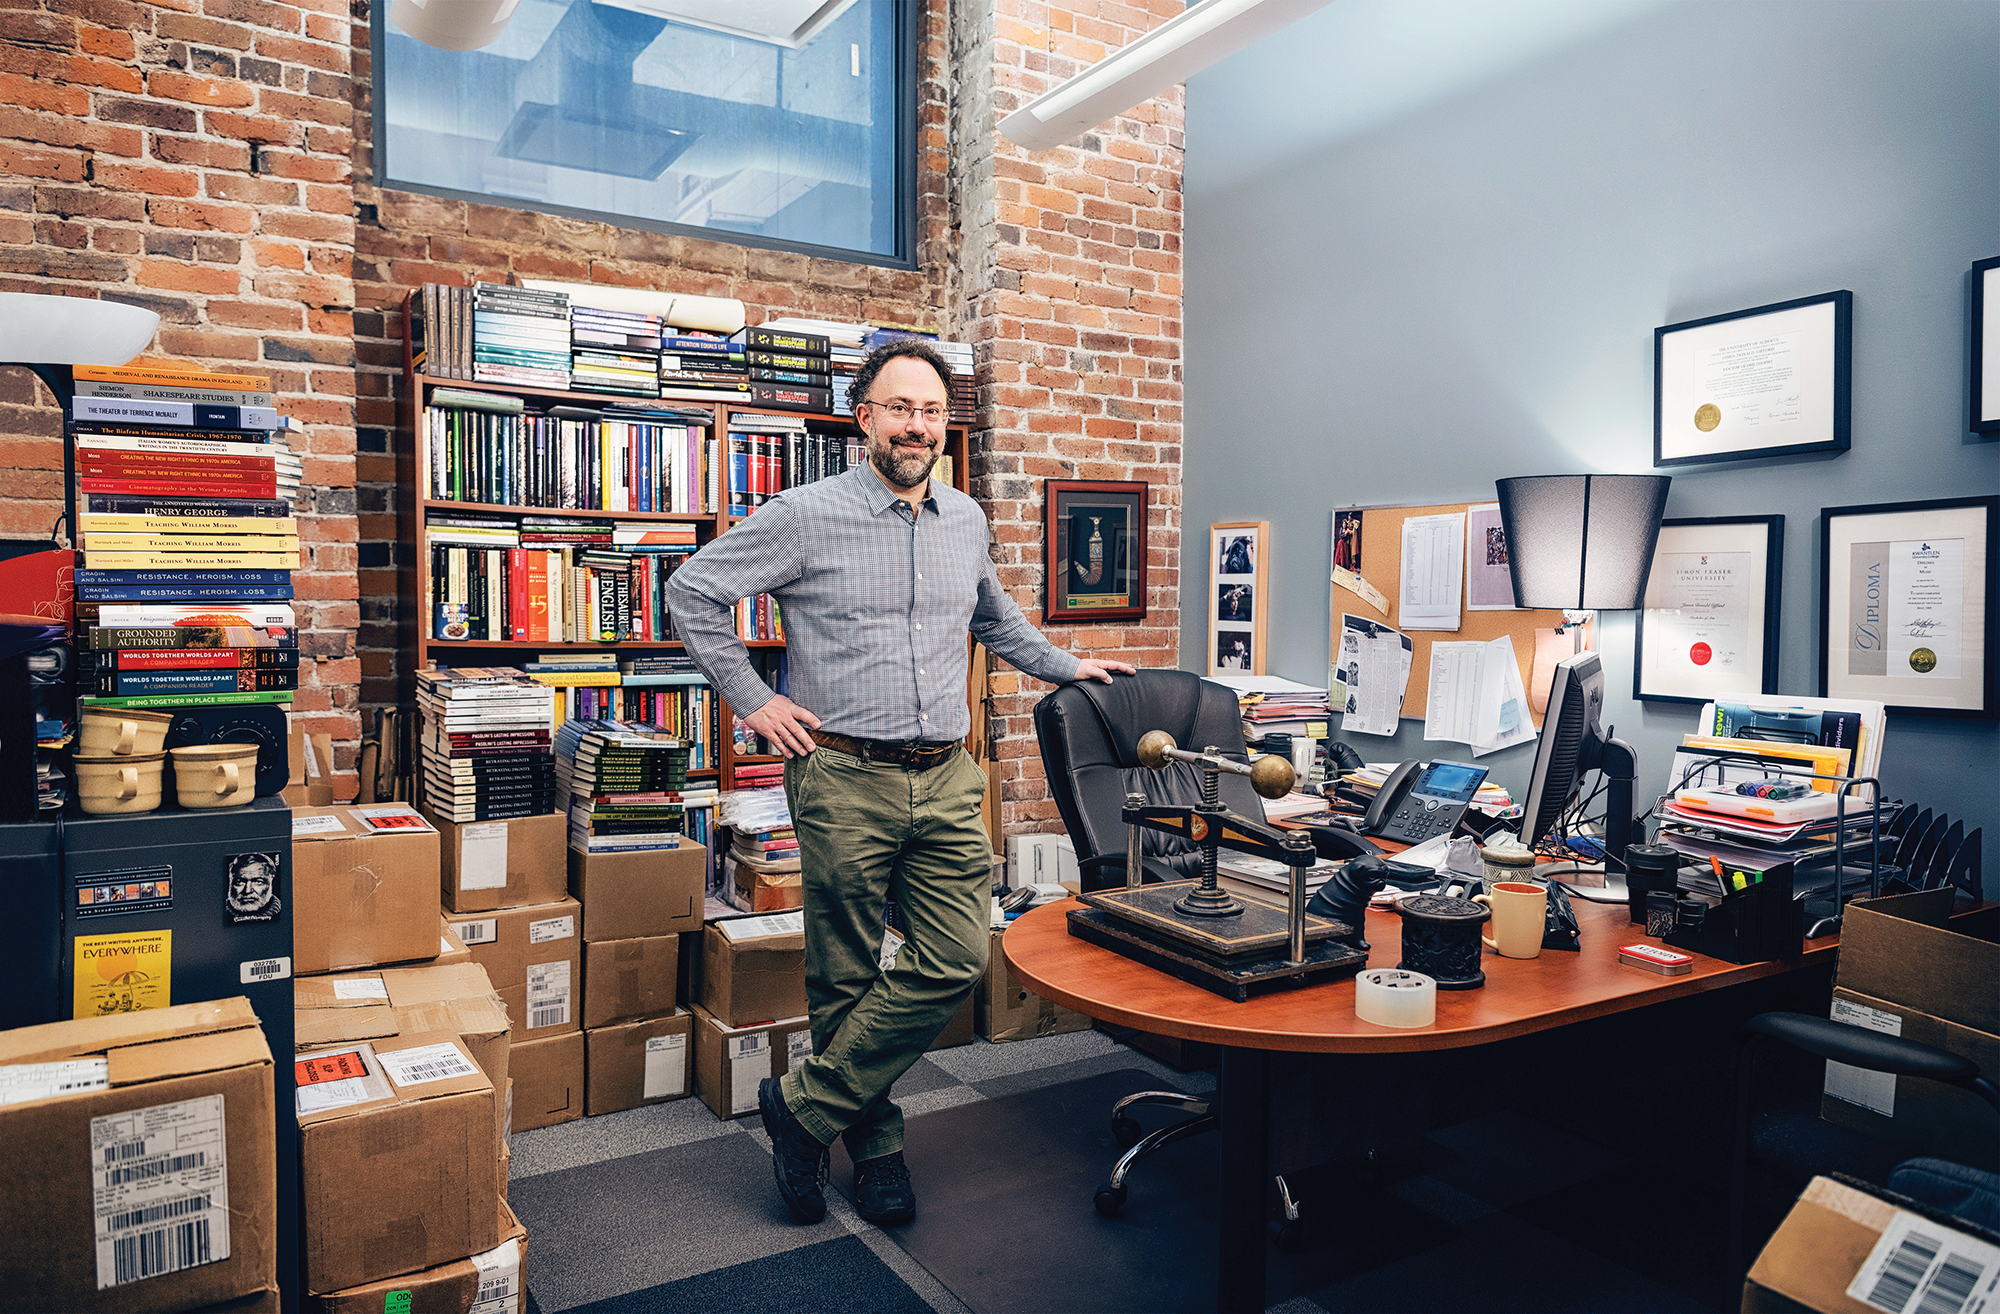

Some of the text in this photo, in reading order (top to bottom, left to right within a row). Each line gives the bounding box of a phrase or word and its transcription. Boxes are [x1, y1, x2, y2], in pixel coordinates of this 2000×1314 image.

[143, 390, 200, 400] SHAKESPEARE
[602, 580, 614, 630] ENGLISH
[1854, 562, 1880, 653] DIPLOMA
[1716, 708, 1724, 737] new!
[1836, 717, 1844, 748] dividers
[84, 944, 162, 959] EVERYWHERE
[304, 1061, 319, 1082] ENCLOSED
[323, 1064, 333, 1072] SLIP
[338, 1057, 352, 1075] PACKING
[482, 1277, 509, 1289] 209 9-01
[499, 1300, 504, 1308] 2
